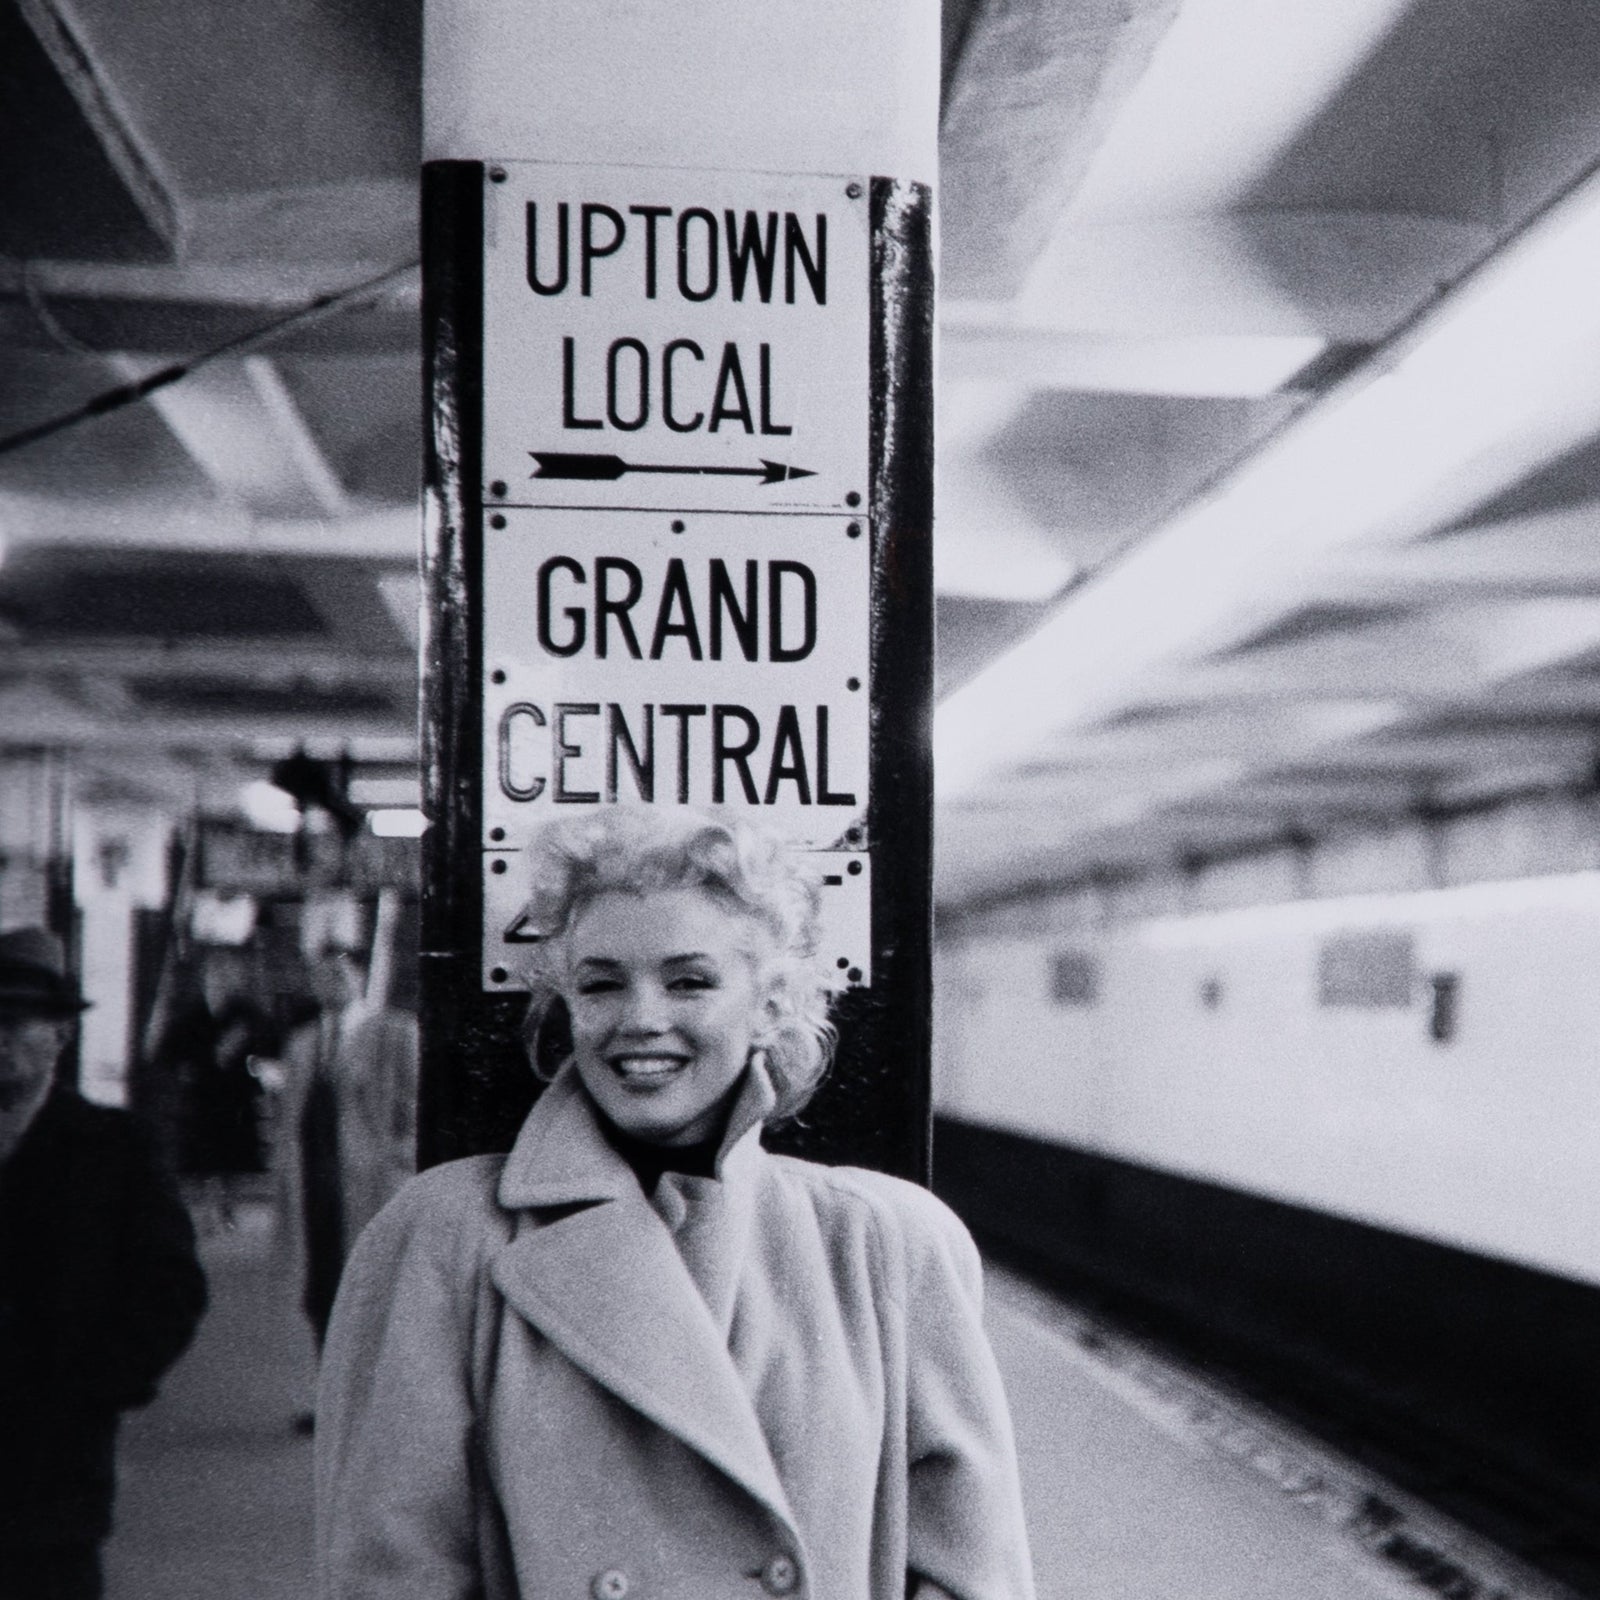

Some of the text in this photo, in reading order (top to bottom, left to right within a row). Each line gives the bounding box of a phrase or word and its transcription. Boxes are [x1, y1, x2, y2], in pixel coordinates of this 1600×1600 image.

[525, 201, 827, 306] UPTOWN
[562, 337, 793, 436] LOCAL
[537, 555, 818, 663] GRAND
[497, 701, 857, 807] CENTRAL
